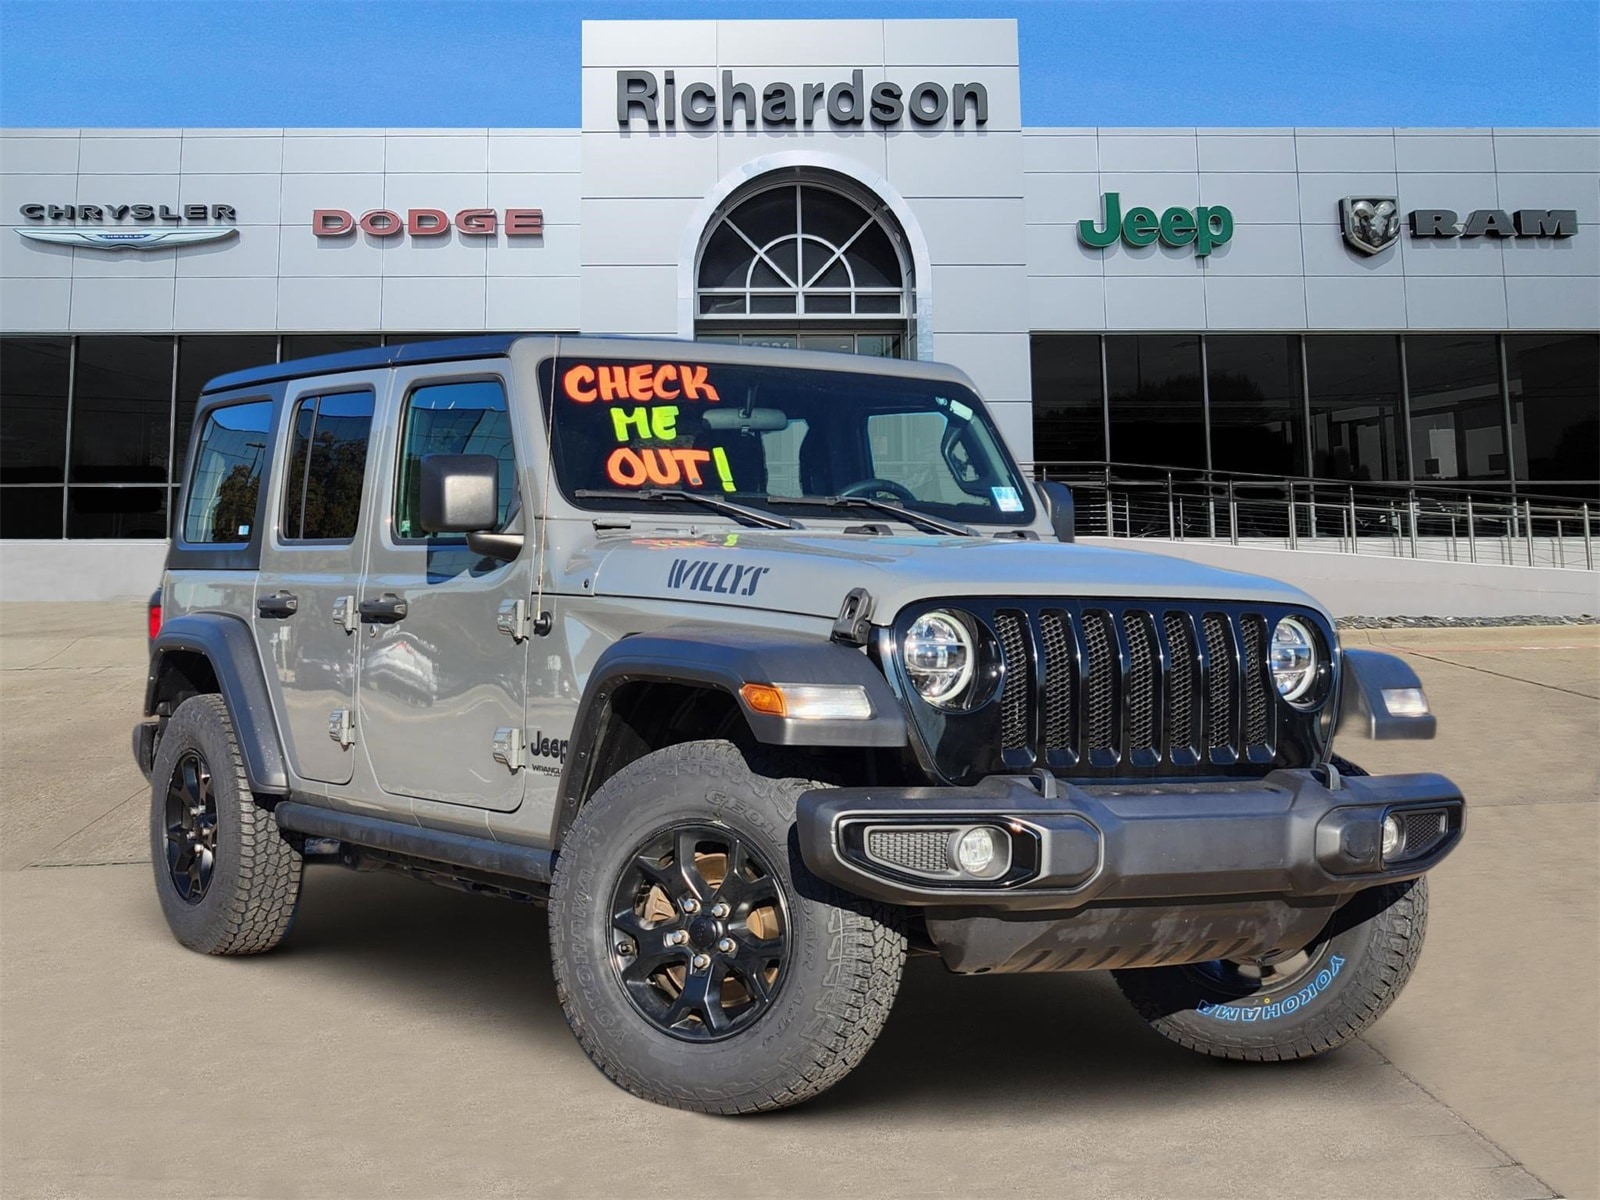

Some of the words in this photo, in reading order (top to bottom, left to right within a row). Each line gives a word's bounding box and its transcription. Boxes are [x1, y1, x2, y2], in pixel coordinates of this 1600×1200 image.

[617, 69, 989, 126] Richardson
[19, 204, 237, 220] CHRYSLER
[312, 208, 544, 237] DODGE
[1076, 192, 1235, 257] Jeep
[1408, 209, 1578, 238] RAM
[563, 364, 721, 403] CHECK
[609, 406, 680, 442] ME
[606, 446, 737, 492] OUT!
[667, 558, 770, 596] WILLYS
[531, 731, 569, 764] Jeep
[532, 764, 564, 774] WRANGL
[571, 869, 627, 1044] YOKOHAMA
[1196, 955, 1346, 1021] YOKOHAMA
